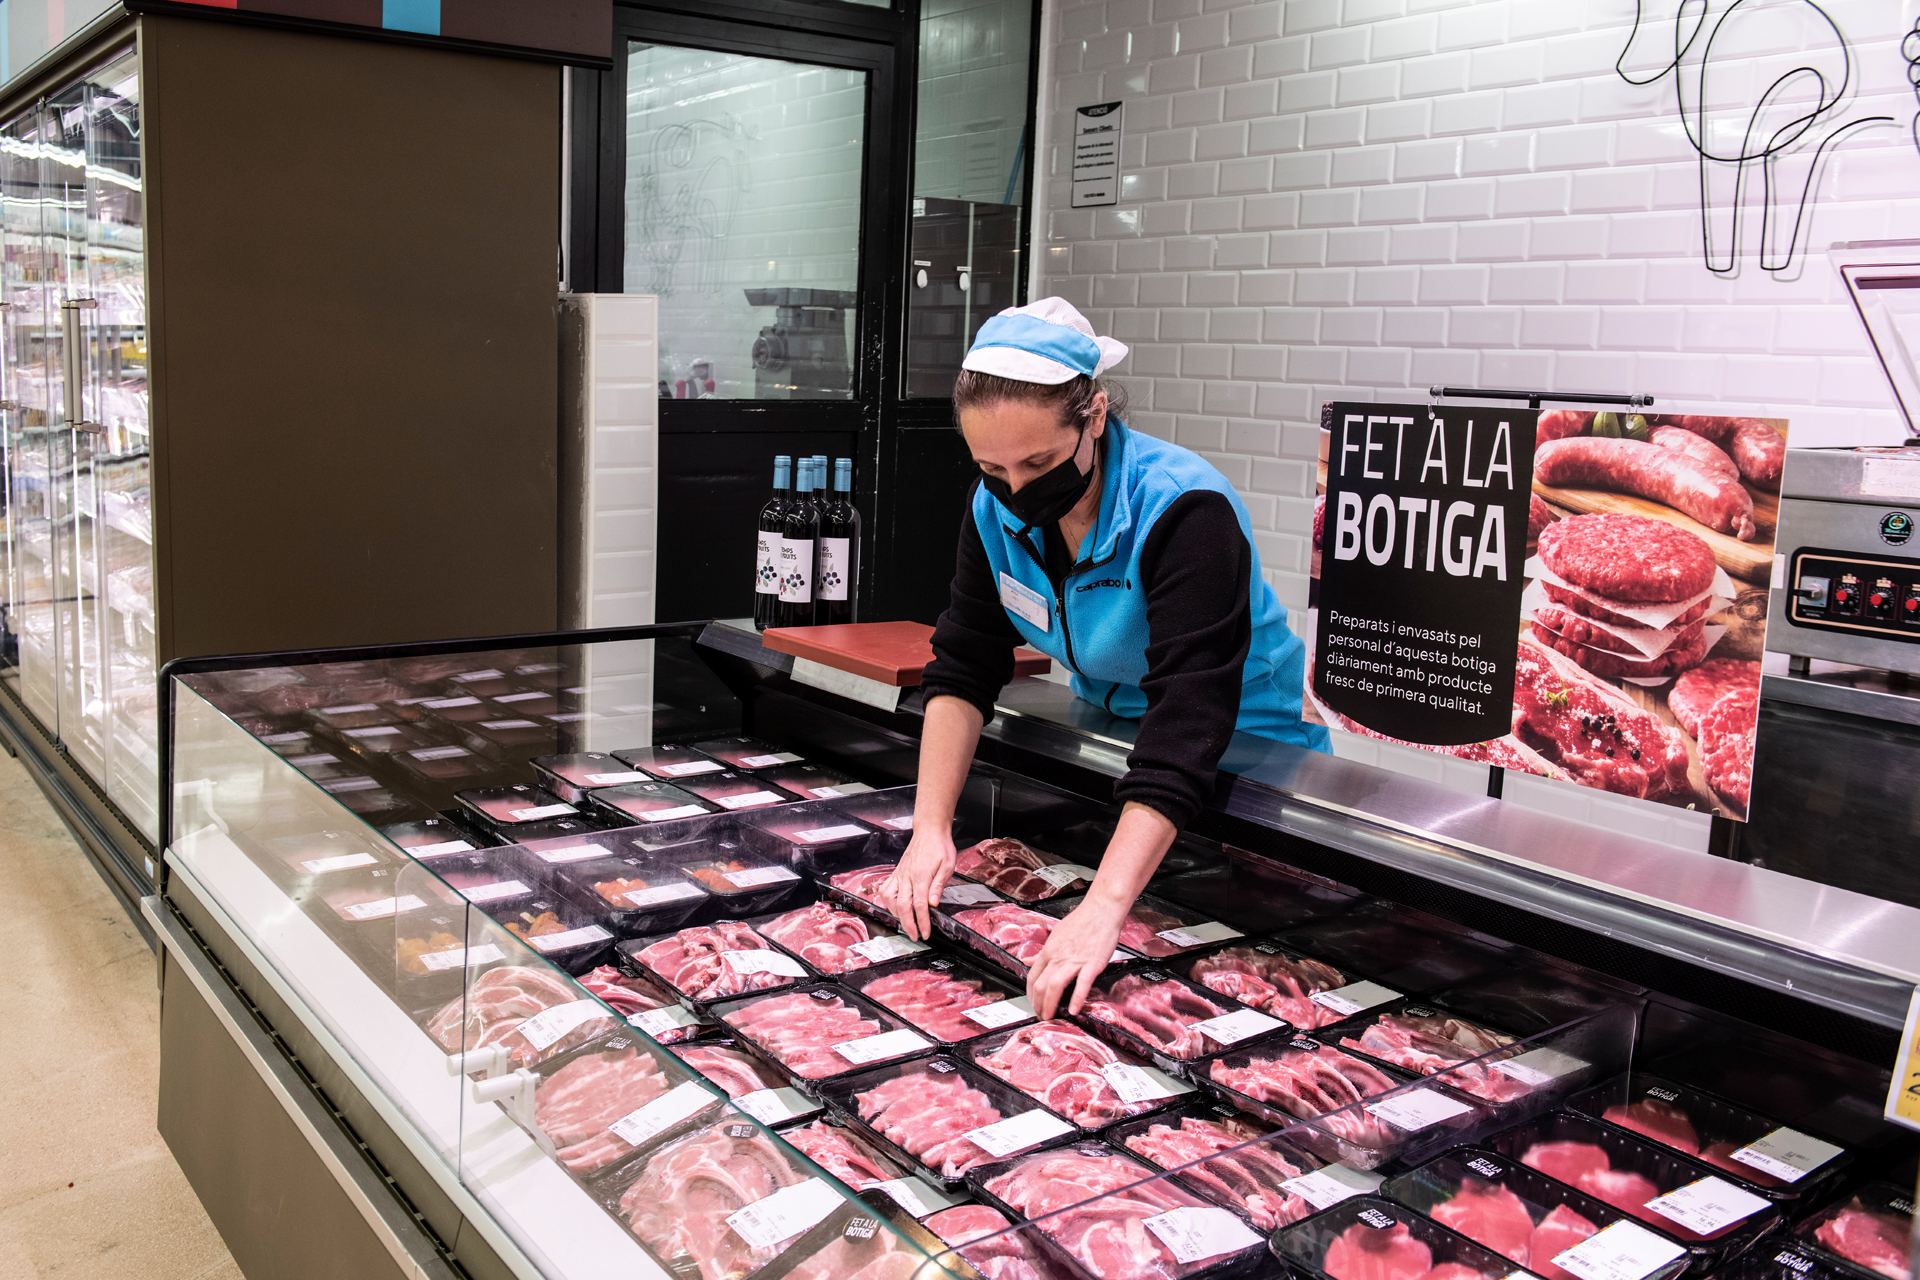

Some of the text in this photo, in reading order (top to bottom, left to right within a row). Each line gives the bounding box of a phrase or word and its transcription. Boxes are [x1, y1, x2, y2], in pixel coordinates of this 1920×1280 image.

[1340, 414, 1414, 481] FET
[1462, 420, 1514, 490] LA
[1334, 491, 1507, 582] BOTIGA
[1076, 577, 1121, 592] caprabo
[1330, 610, 1481, 649] Preparats i envasats pel
[1328, 634, 1381, 652] personal
[1451, 652, 1496, 675] botiga
[1327, 651, 1493, 695] diàriament amb producte
[1326, 670, 1485, 716] fresc de primera qualitat.
[1466, 1161, 1495, 1177] BOTIGA
[1475, 1157, 1490, 1166] FET
[1357, 1211, 1386, 1229] BOTIGA
[1366, 1208, 1383, 1218] FET
[845, 1226, 874, 1239] BOTIGA
[850, 1218, 865, 1227] FET
[869, 1220, 879, 1229] LA
